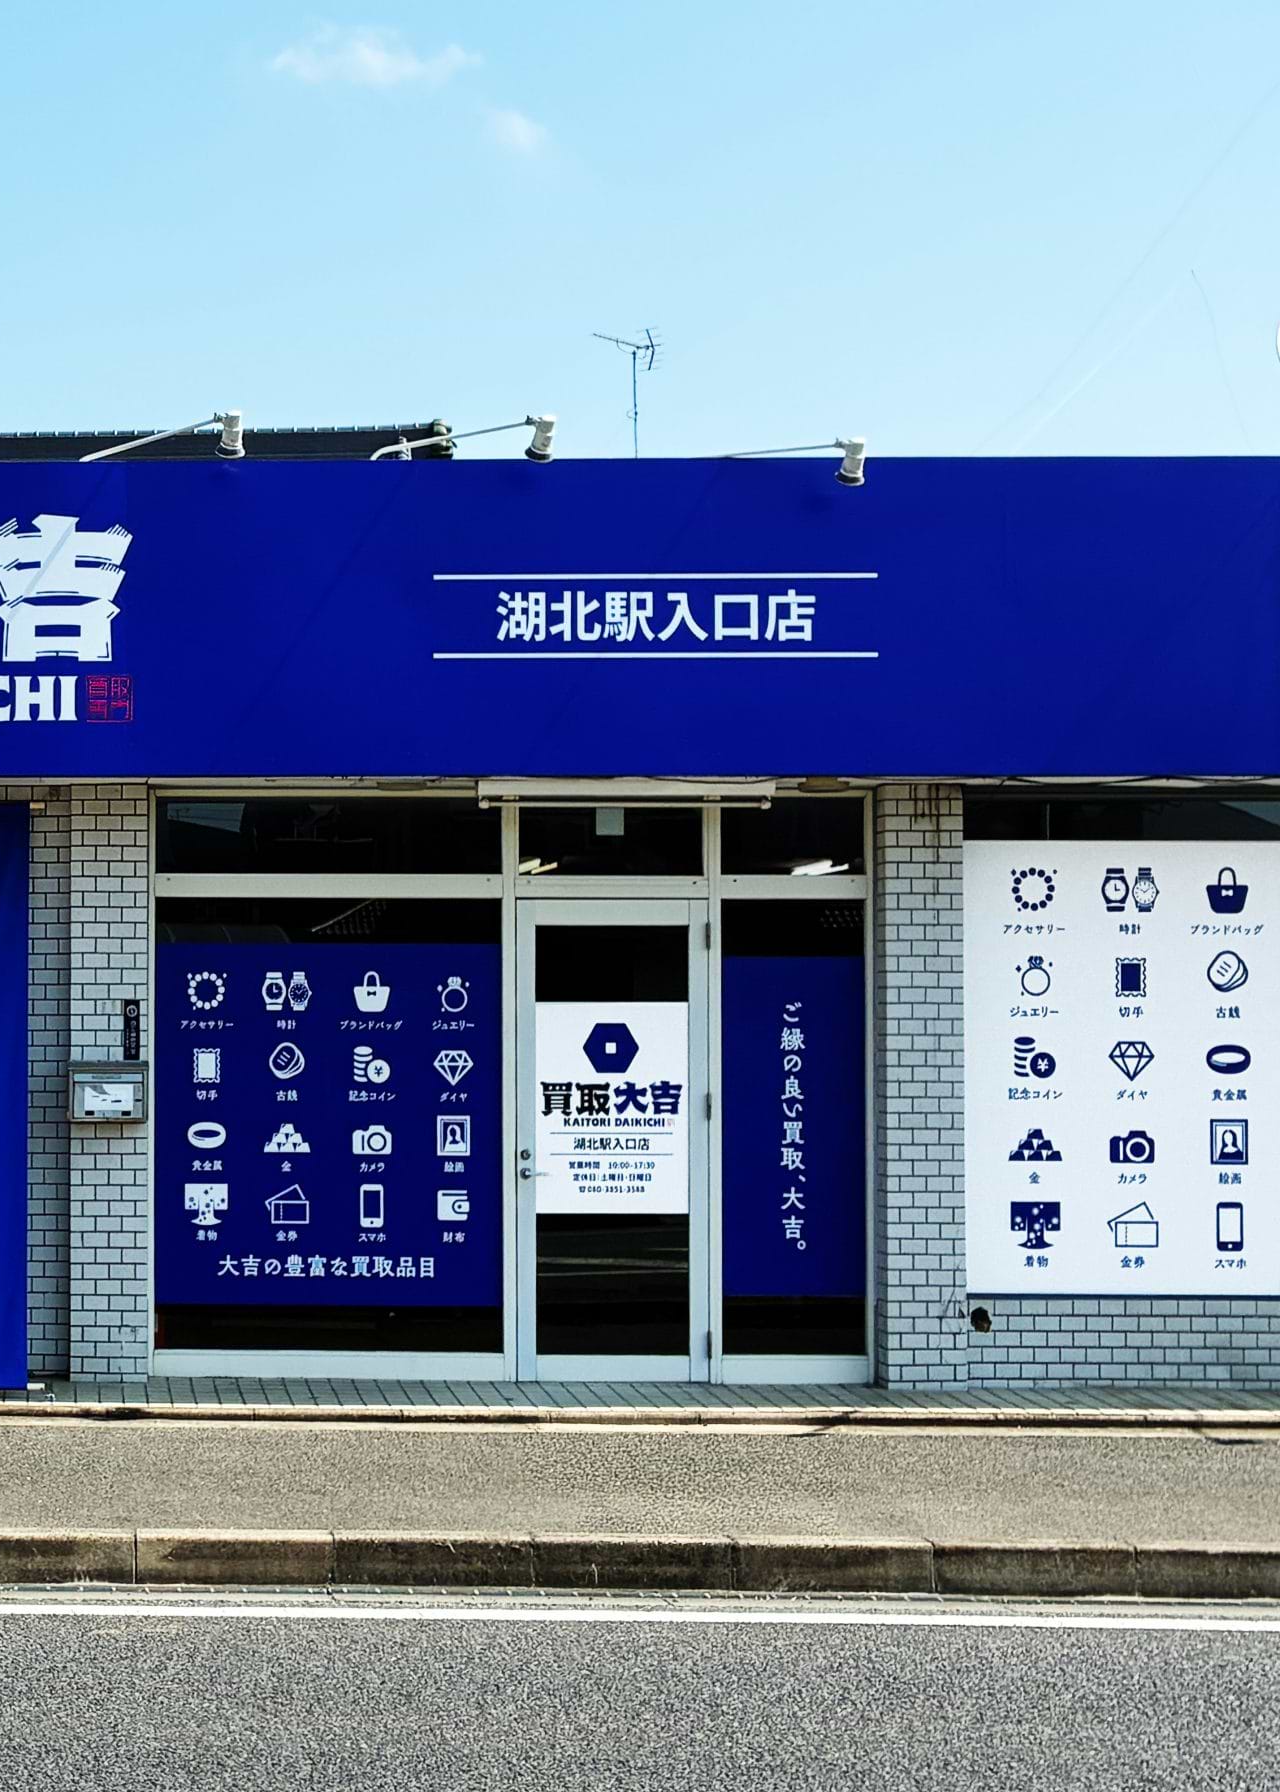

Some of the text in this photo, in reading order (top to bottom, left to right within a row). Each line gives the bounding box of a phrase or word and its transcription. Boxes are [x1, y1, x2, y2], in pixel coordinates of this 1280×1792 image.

[497, 589, 816, 641] 湖北駅入口店
[1004, 924, 1065, 934] アクセサリー
[1120, 924, 1140, 934] 時計
[1191, 924, 1264, 935] ブランドバッグ
[1010, 1006, 1058, 1017] ジュエリー
[1119, 1006, 1143, 1018] 切手
[181, 1020, 233, 1029] アクセサリー
[277, 1020, 296, 1029] 時計
[341, 1020, 402, 1030] ブランドバッグ
[433, 1020, 474, 1030] ジュエリー
[197, 1090, 217, 1100] 切手
[349, 1090, 395, 1101] 記念コイン
[440, 1092, 467, 1102] ダイヤ
[540, 1081, 682, 1116] 買取大吉
[1008, 1088, 1062, 1100] 記念コイン
[1117, 1090, 1147, 1100] ダイヤ
[1212, 1089, 1247, 1101] 貴金属
[564, 1118, 610, 1127] KAITORI
[615, 1118, 665, 1127] DAIKICHI
[780, 1002, 806, 1250] ご縁の良い買取、大吉。
[574, 1138, 649, 1150] 湖北駅入口店
[282, 1161, 291, 1172] 金
[360, 1162, 384, 1172] カメラ
[1029, 1172, 1040, 1184] 金
[1118, 1173, 1147, 1184] カメラ
[359, 1233, 386, 1242] スマホ
[218, 1255, 434, 1277] 大吉の豊富な買取品目
[1024, 1255, 1048, 1267] 着物
[1215, 1259, 1246, 1269] スマホ
